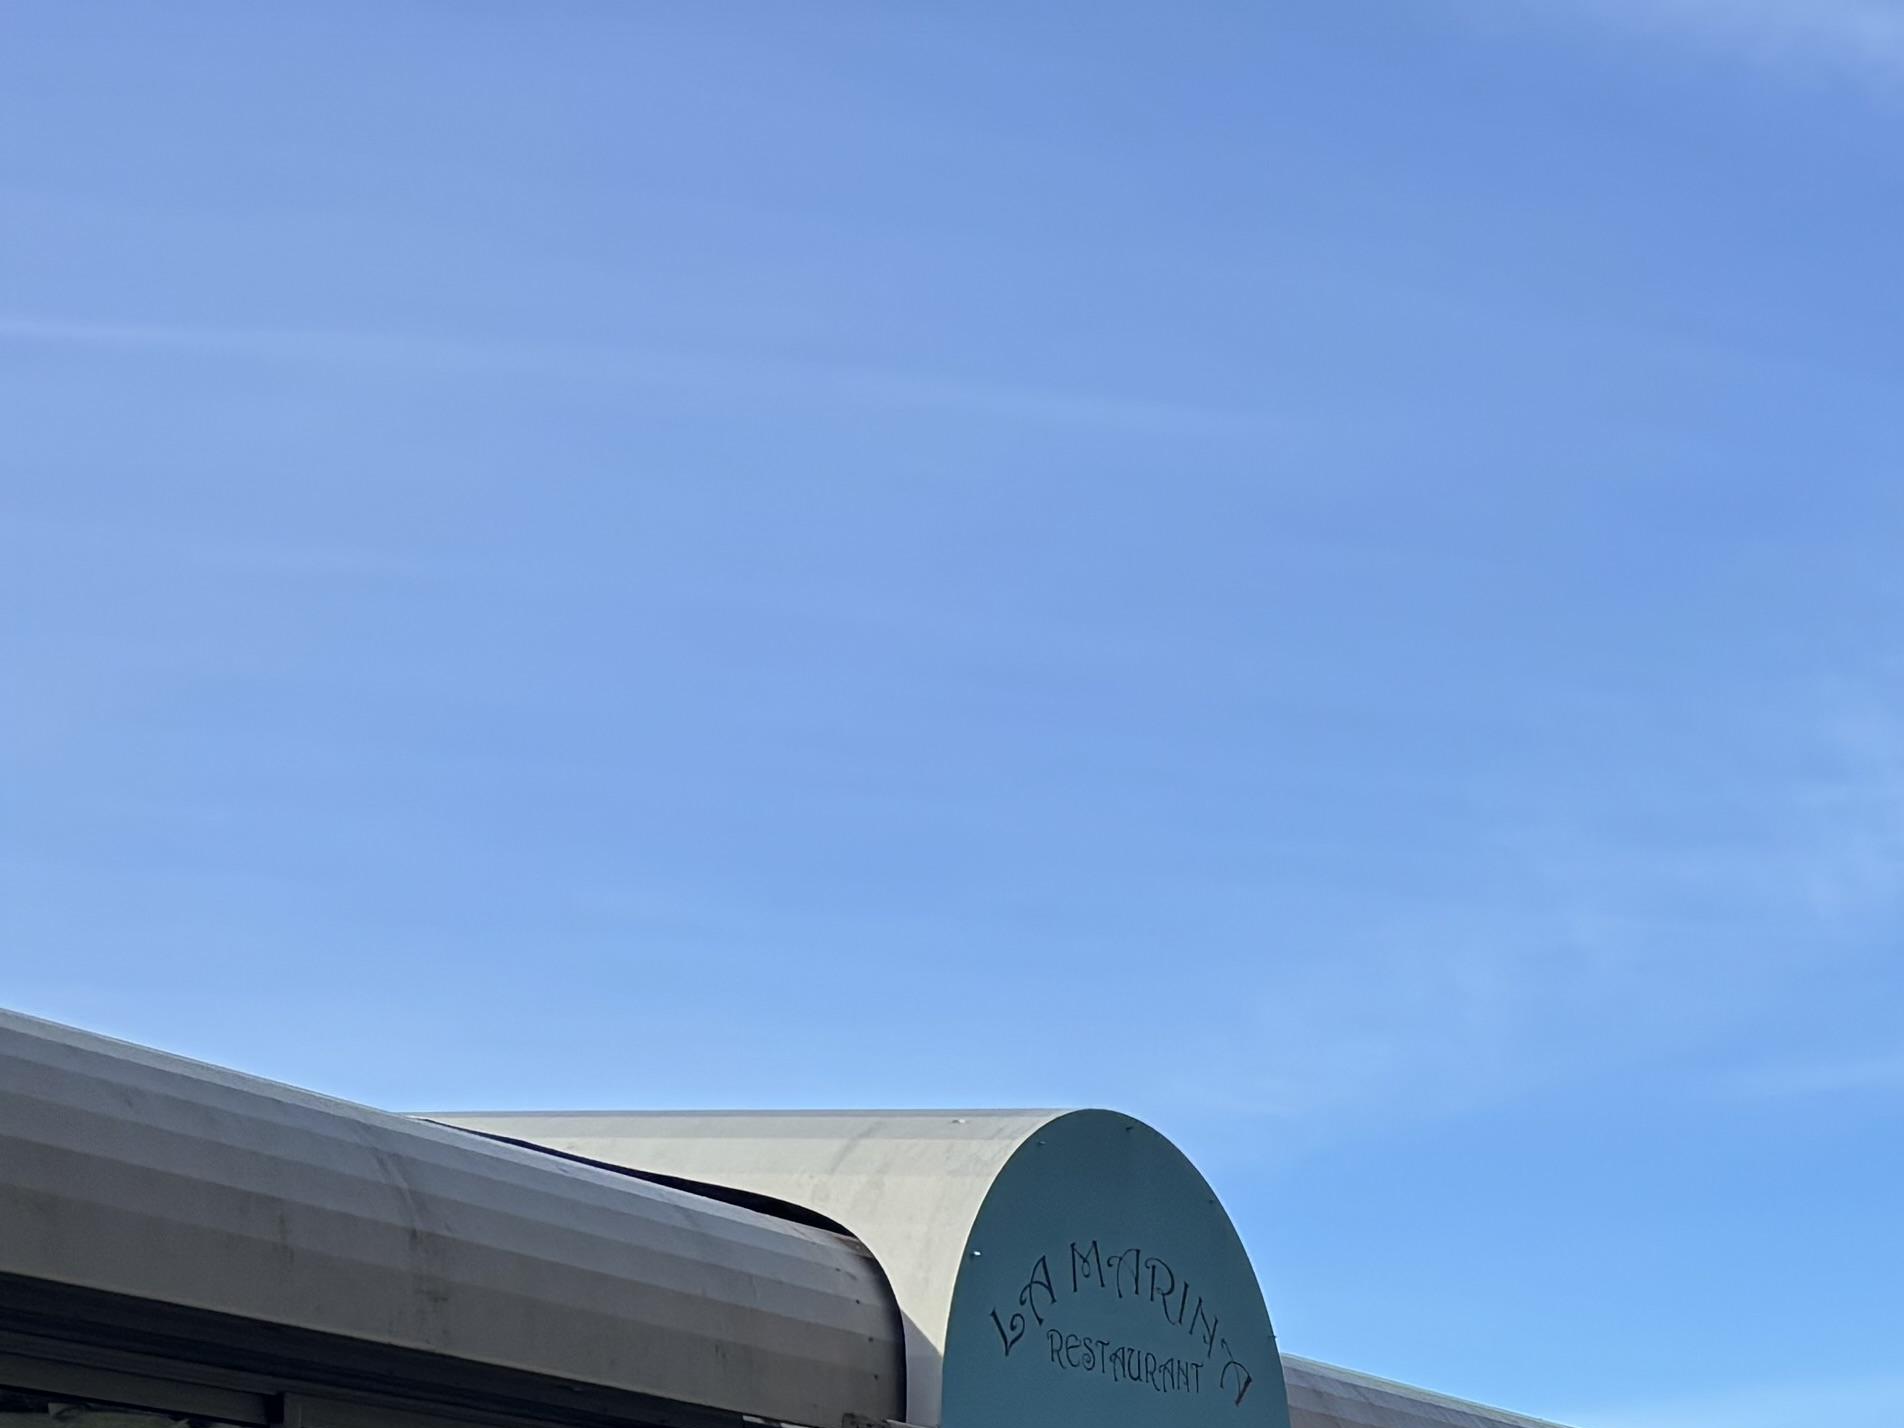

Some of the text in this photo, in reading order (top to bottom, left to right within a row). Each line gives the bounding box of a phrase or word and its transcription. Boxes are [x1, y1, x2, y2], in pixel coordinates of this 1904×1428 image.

[990, 1240, 1253, 1406] LA MARINA
[1047, 1328, 1204, 1393] RESTAURANT
